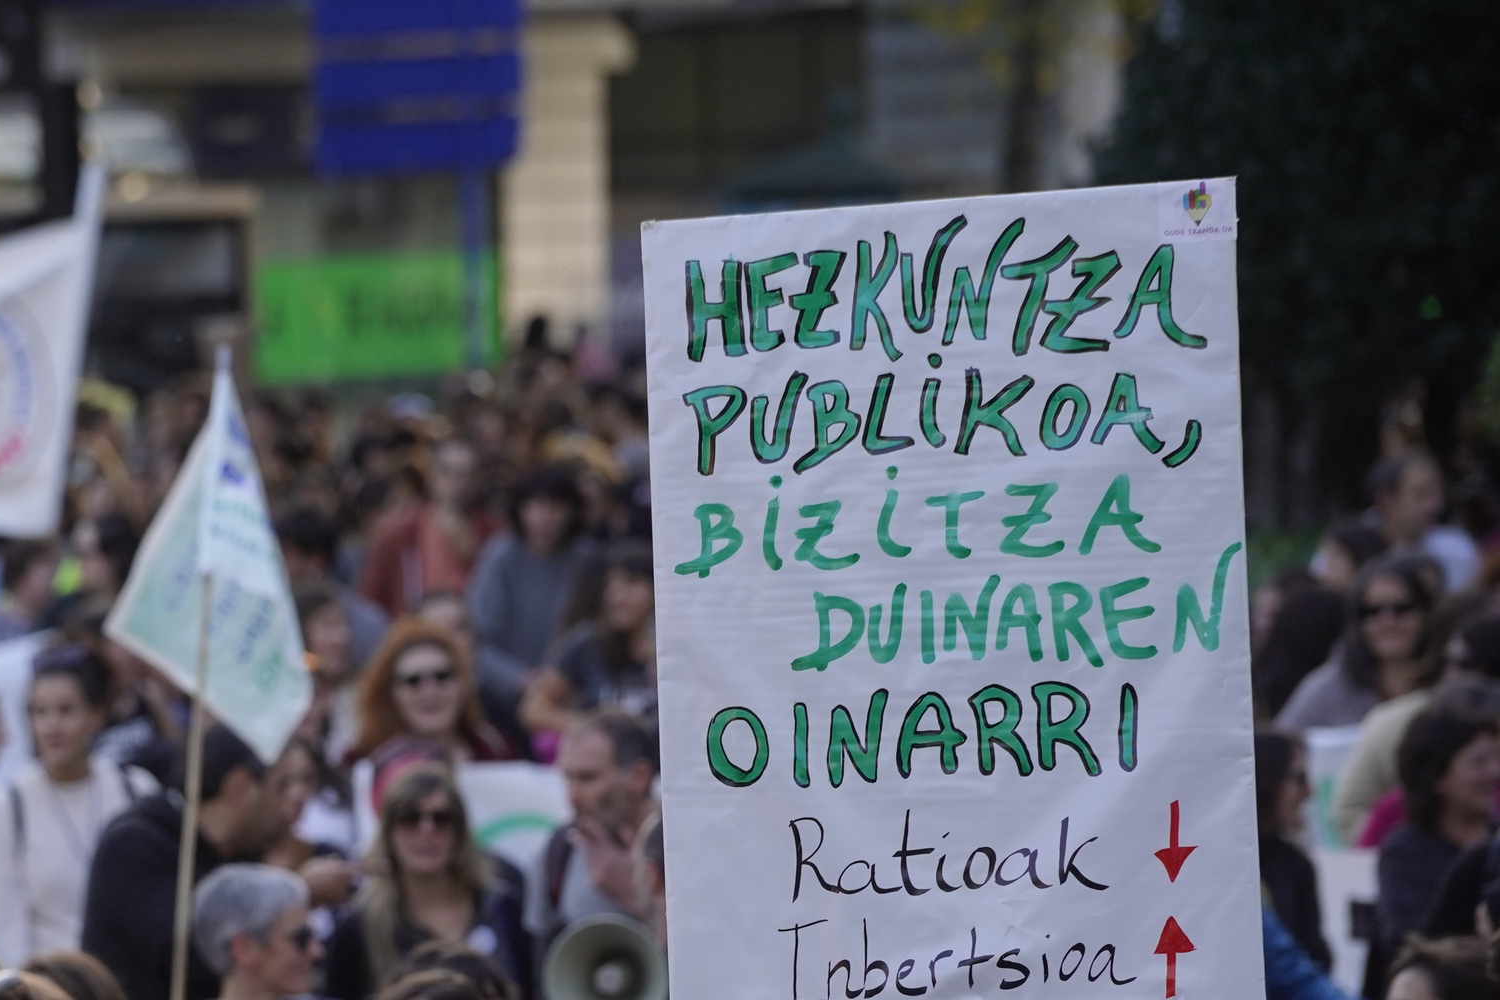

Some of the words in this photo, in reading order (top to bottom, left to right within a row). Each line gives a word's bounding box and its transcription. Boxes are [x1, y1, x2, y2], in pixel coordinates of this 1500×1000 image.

[1188, 226, 1220, 235] TXANDA
[1221, 225, 1233, 233] DA
[684, 214, 1208, 363] HEZKUNTZA
[790, 541, 1243, 672] DUINAREN
[705, 680, 1139, 789] OINARRI
[788, 808, 1110, 904] Ratioak
